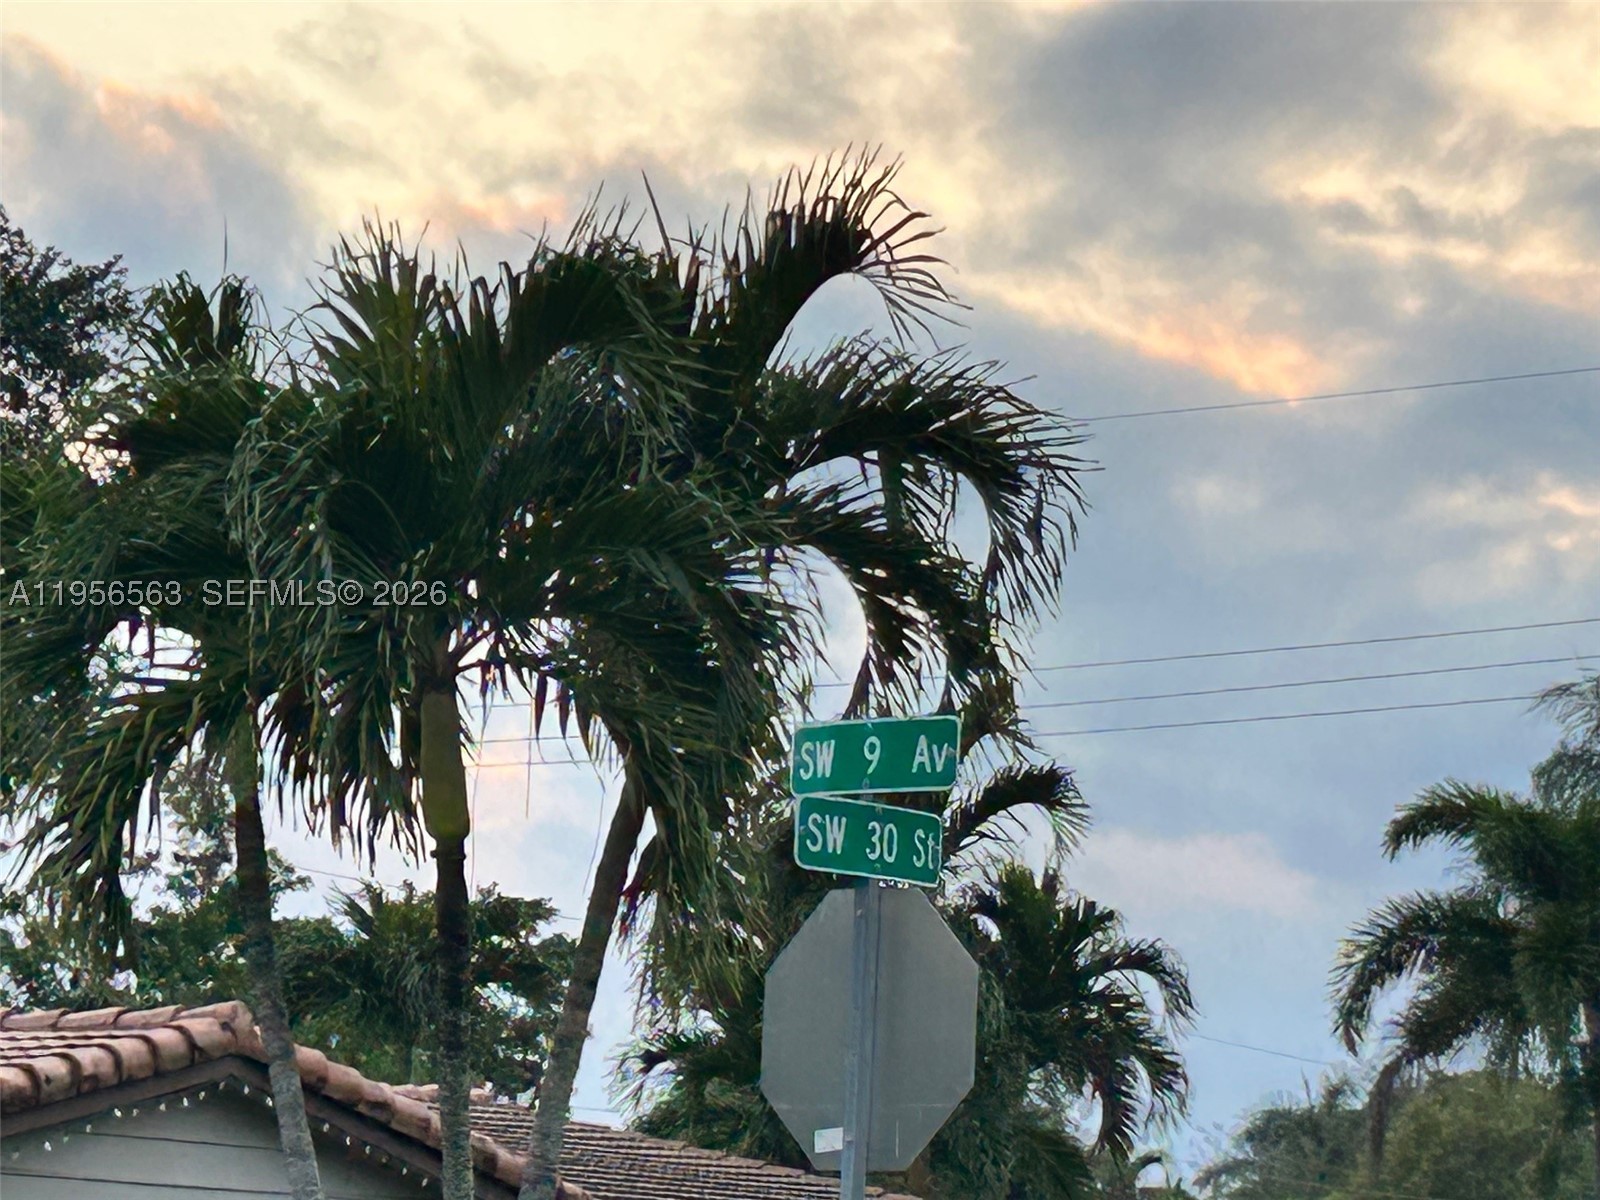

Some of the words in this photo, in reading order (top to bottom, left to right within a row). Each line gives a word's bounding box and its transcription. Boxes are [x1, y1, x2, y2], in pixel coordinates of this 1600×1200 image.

[799, 739, 836, 781] SW
[863, 735, 881, 775] 9
[911, 734, 949, 774] Av
[805, 812, 847, 855] SW
[865, 820, 899, 864] 30
[912, 828, 936, 870] St
